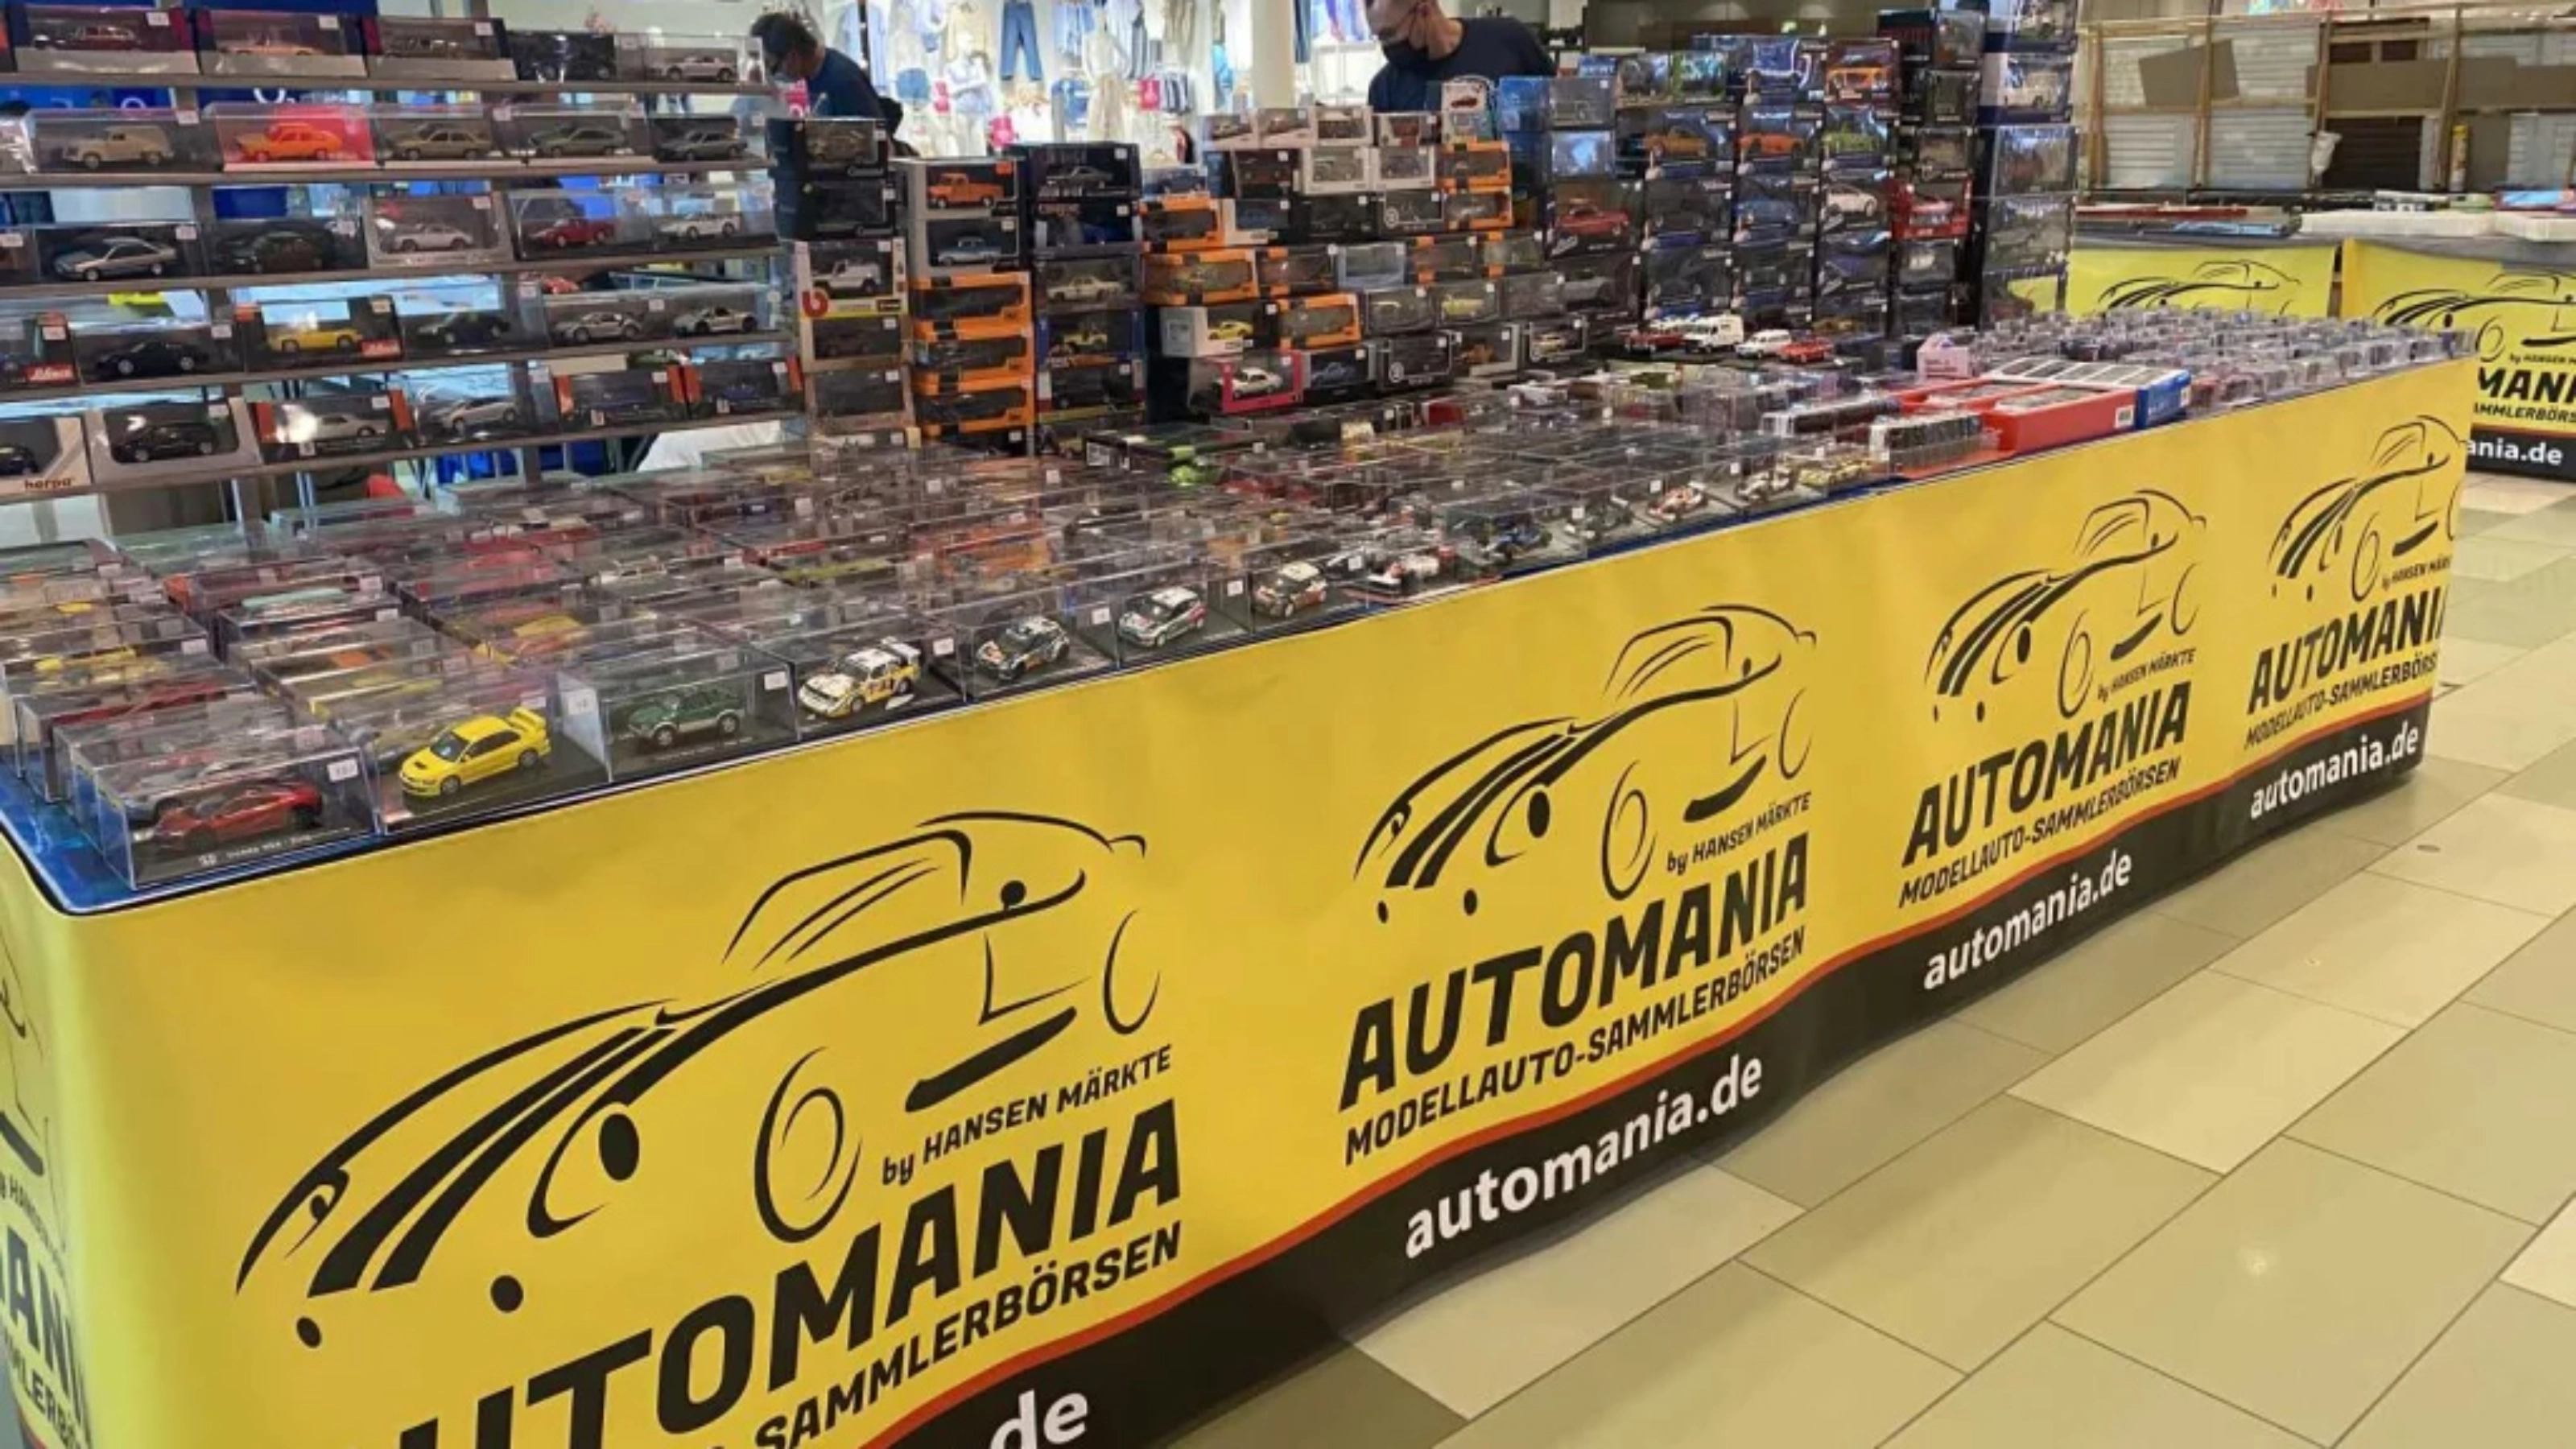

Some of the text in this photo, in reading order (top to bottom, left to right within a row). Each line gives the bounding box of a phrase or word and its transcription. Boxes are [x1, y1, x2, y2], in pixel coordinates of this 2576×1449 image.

[1666, 791, 1812, 875] by HANSEN MÄRKTE
[1899, 757, 2182, 909] MODELLAUTO-SAMMLERBÖRSEN
[1901, 680, 2192, 869] AUTOMANIA
[2251, 720, 2419, 819] automania.de
[1338, 832, 1810, 1113] AUTOMANIA
[1923, 848, 2132, 990] automania.de
[881, 1043, 1173, 1187] by HANSEN MÄRKTE
[1345, 925, 1806, 1166] MODELLAUTO-SAMMLERBÖRSEN
[1405, 1053, 1764, 1259] automania.de
